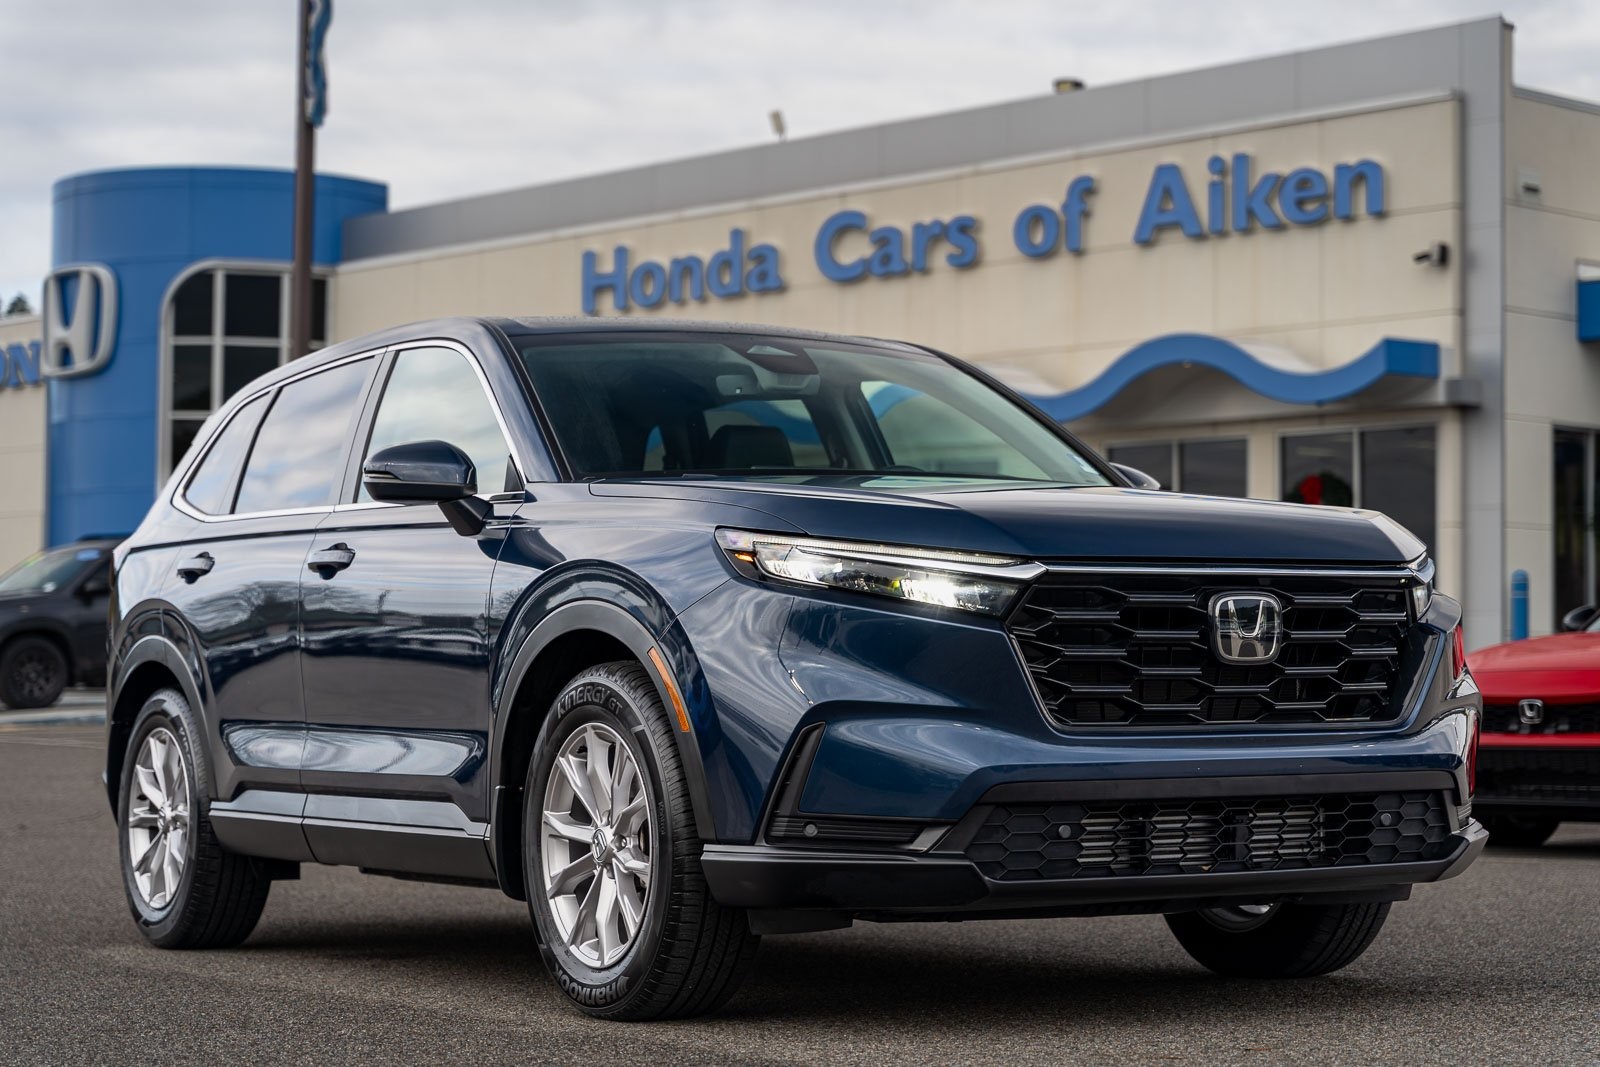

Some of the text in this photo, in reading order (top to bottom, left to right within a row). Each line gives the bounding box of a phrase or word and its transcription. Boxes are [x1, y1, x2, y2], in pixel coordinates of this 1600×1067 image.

[581, 152, 1386, 316] Honda Cars of Aiken
[0, 340, 42, 389] N
[608, 697, 623, 715] GT
